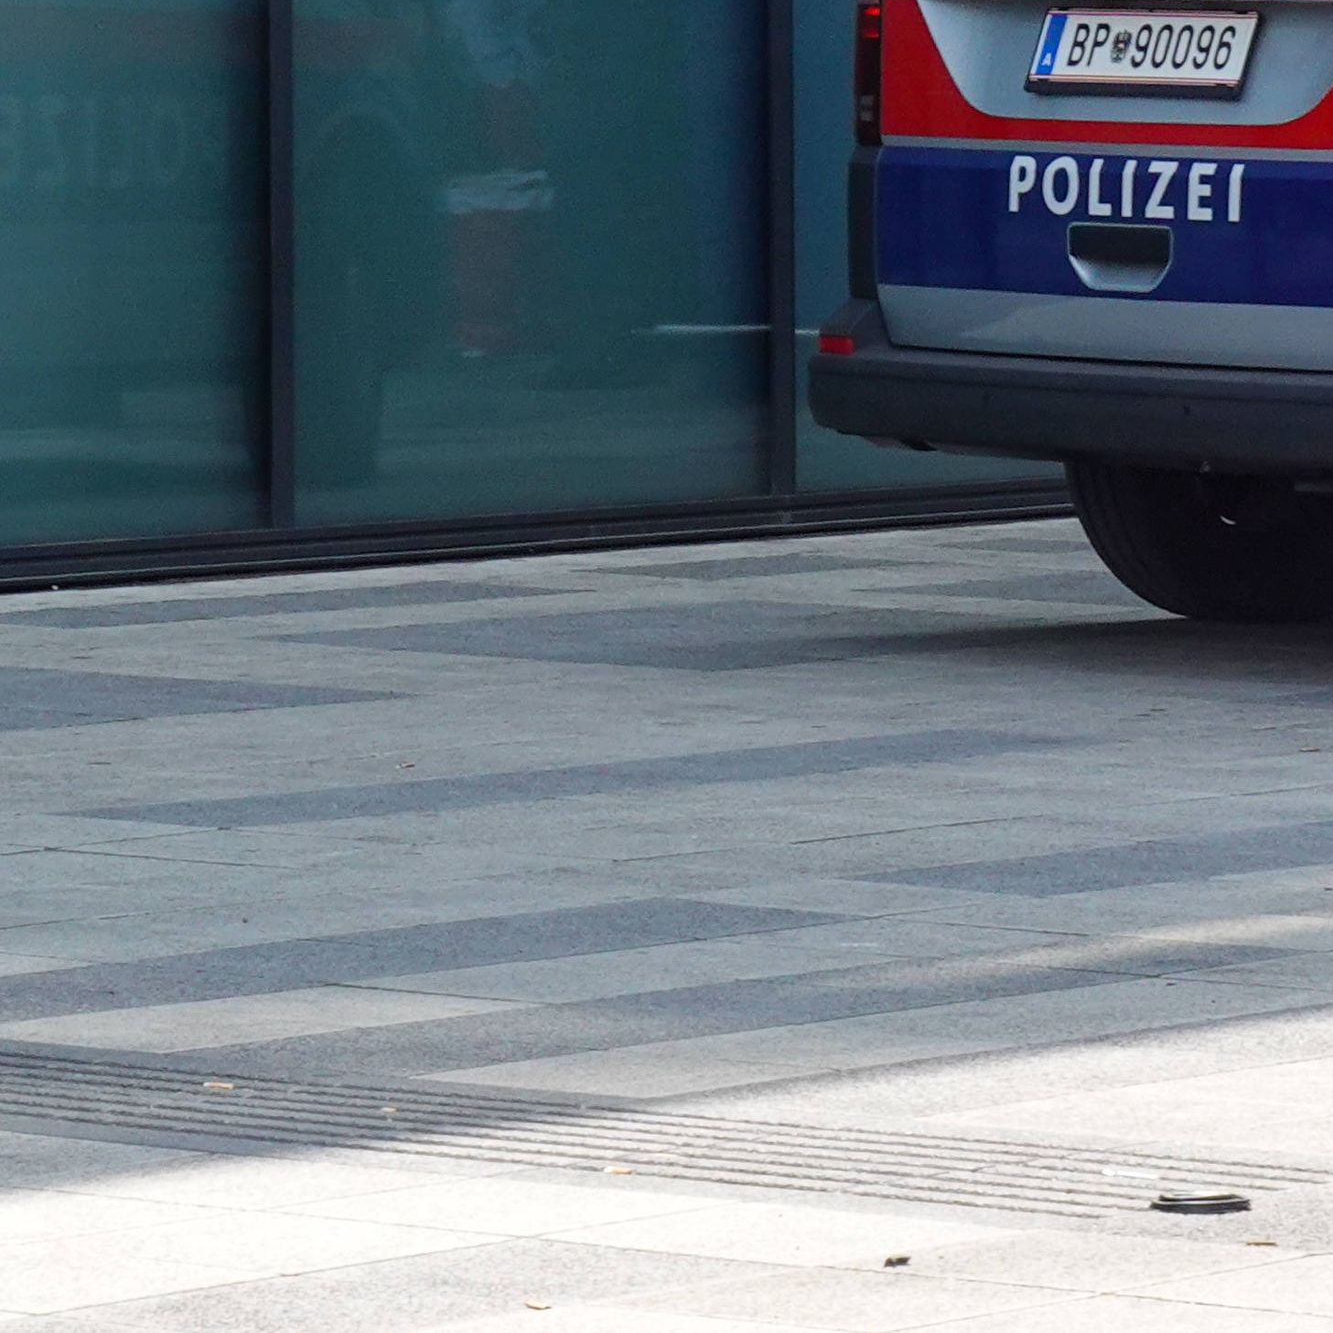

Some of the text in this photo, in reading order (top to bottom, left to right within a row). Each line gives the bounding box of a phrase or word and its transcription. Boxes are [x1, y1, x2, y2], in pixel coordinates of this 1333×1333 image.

[1067, 23, 1236, 70] BP 90096
[1008, 155, 1245, 222] POLIZEI
